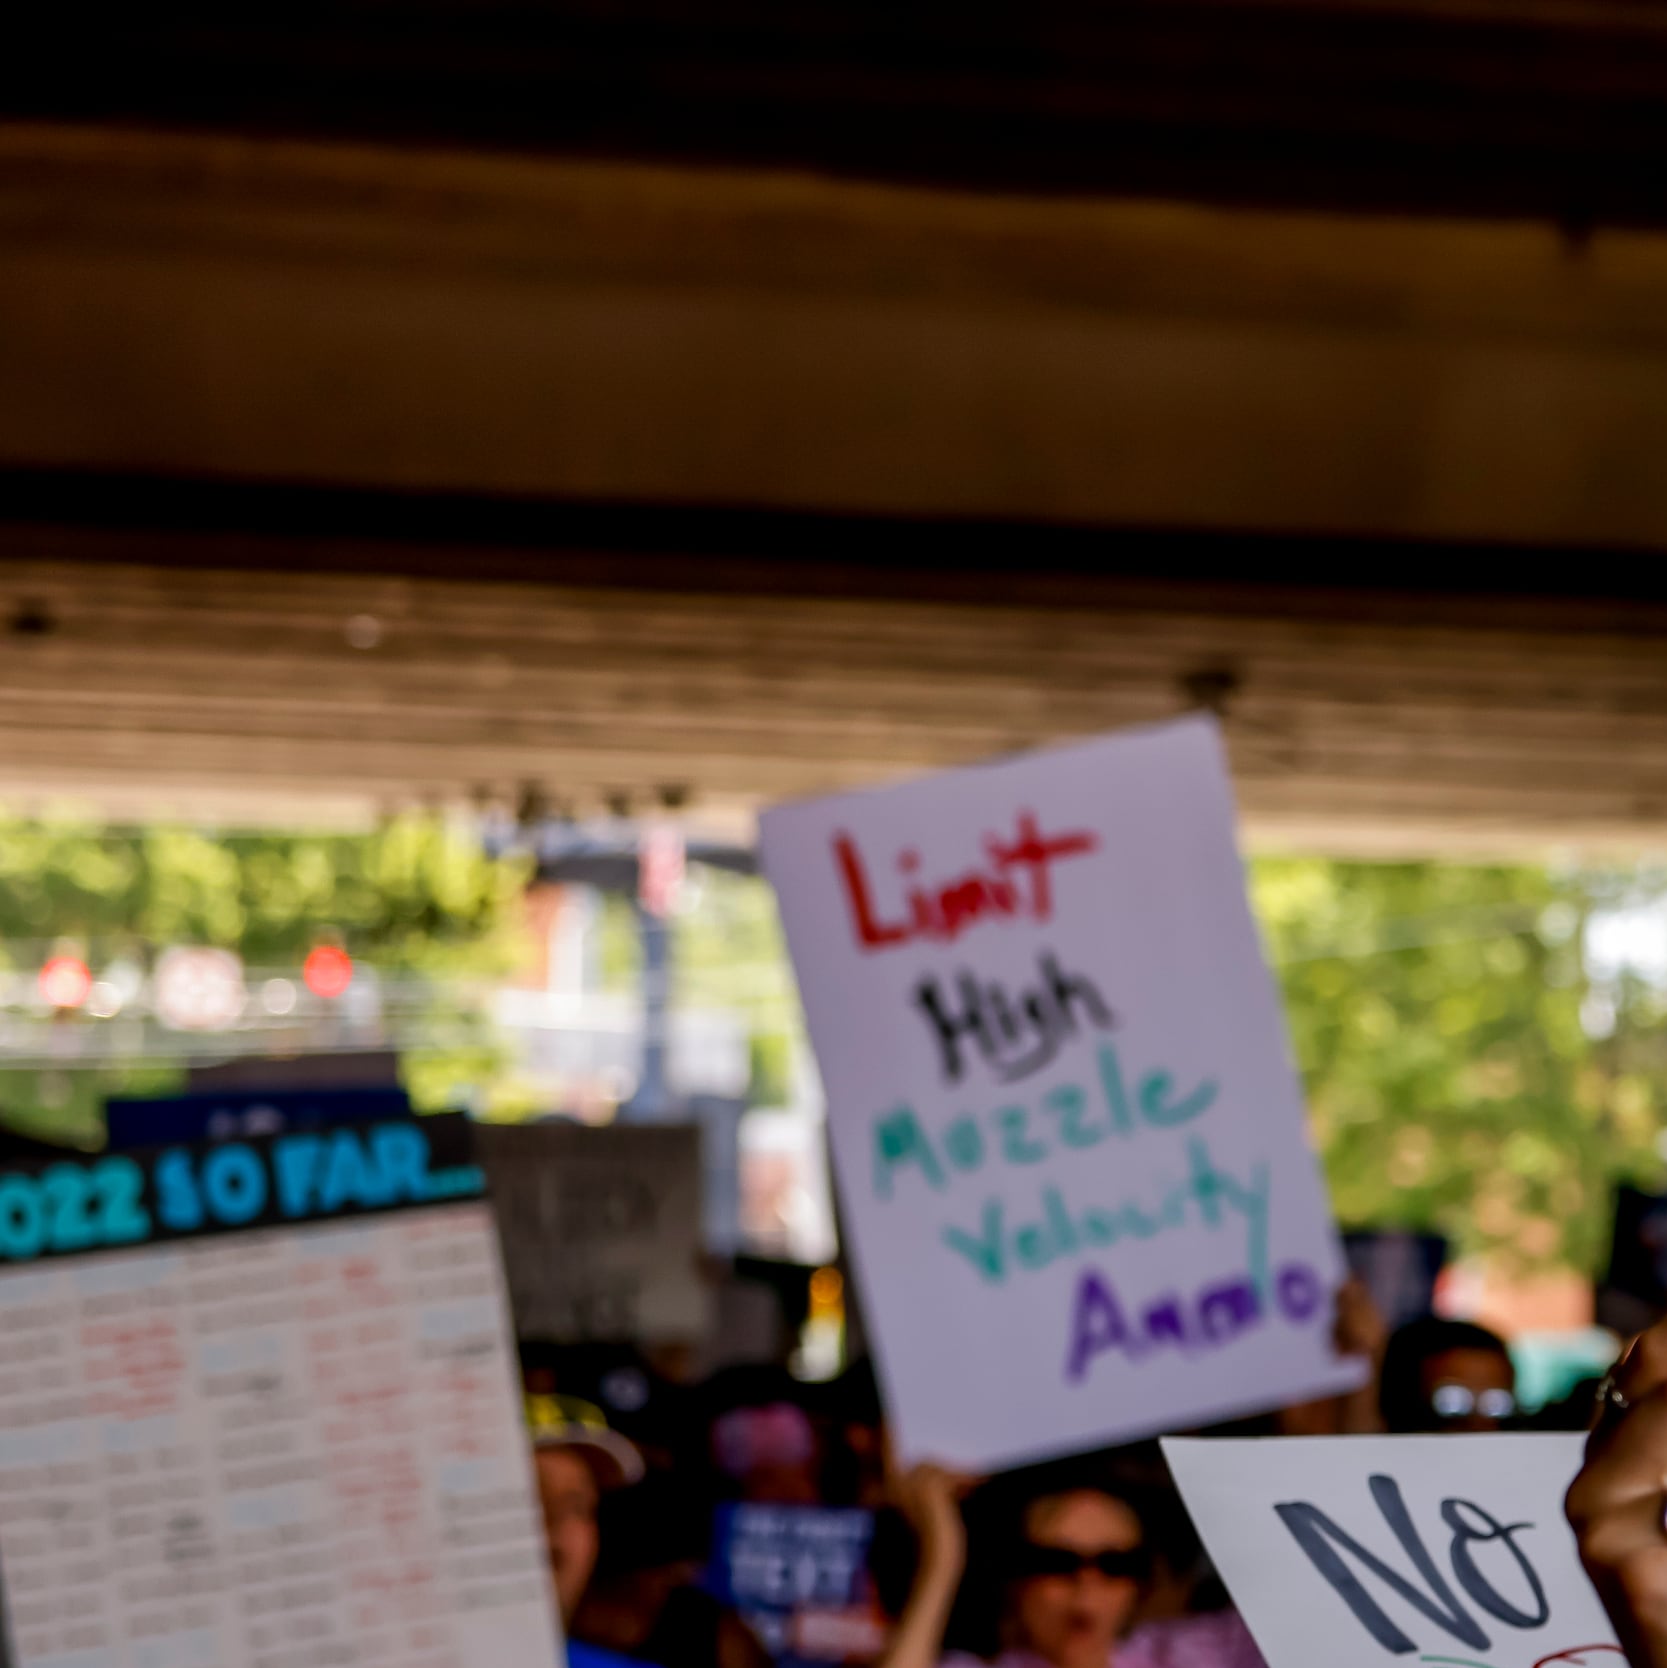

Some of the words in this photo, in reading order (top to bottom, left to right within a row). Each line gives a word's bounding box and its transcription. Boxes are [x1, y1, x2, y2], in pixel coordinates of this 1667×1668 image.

[832, 807, 1100, 953] Limit
[914, 947, 1117, 1085] High
[154, 1142, 268, 1231] SO
